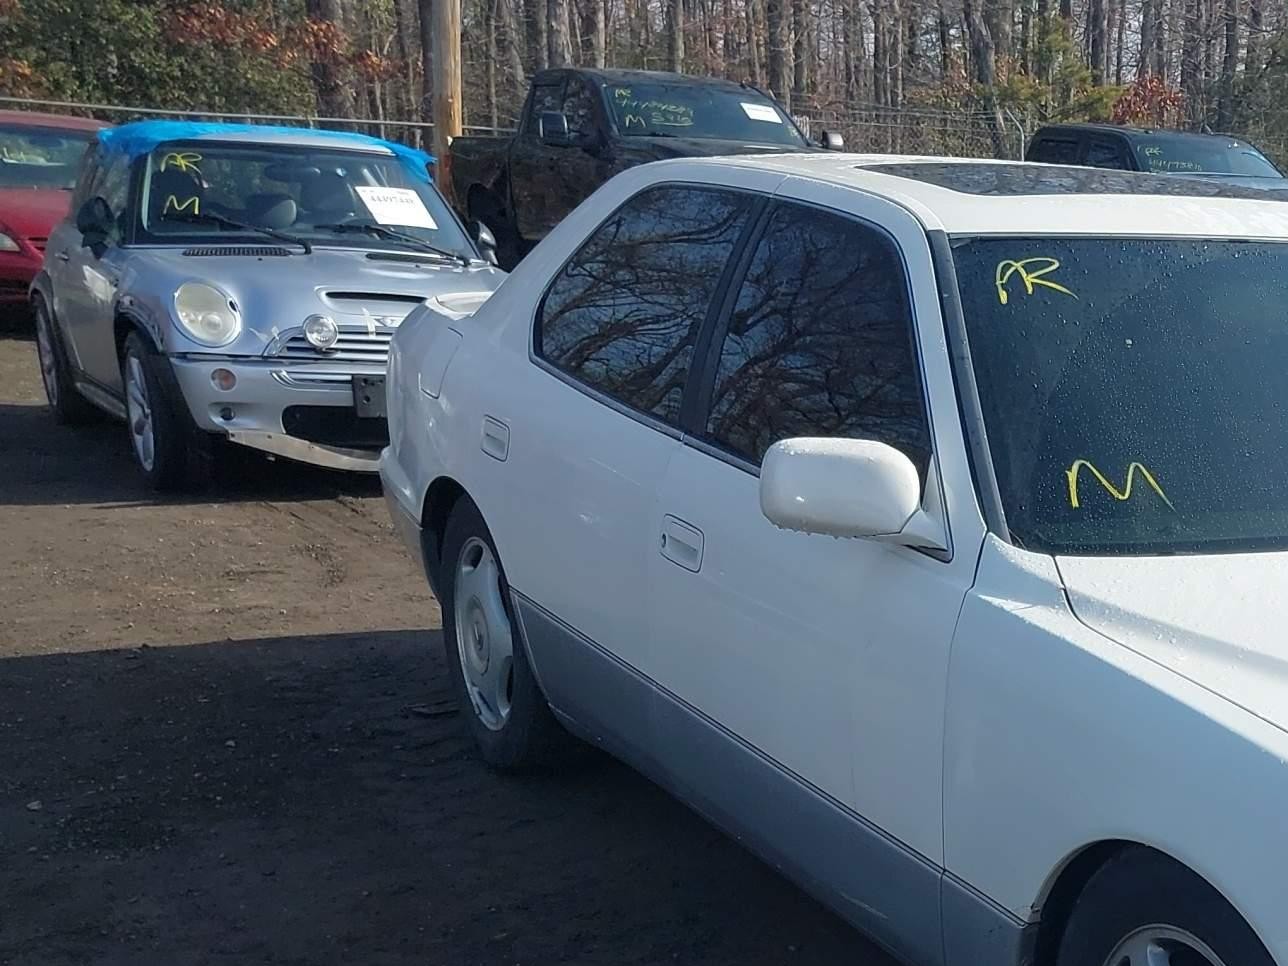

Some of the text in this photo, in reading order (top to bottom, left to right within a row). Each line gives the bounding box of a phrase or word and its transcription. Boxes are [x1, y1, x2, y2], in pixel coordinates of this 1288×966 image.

[625, 114, 647, 128] M
[162, 195, 199, 216] M
[995, 257, 1079, 304] AR
[1065, 459, 1178, 513] M
